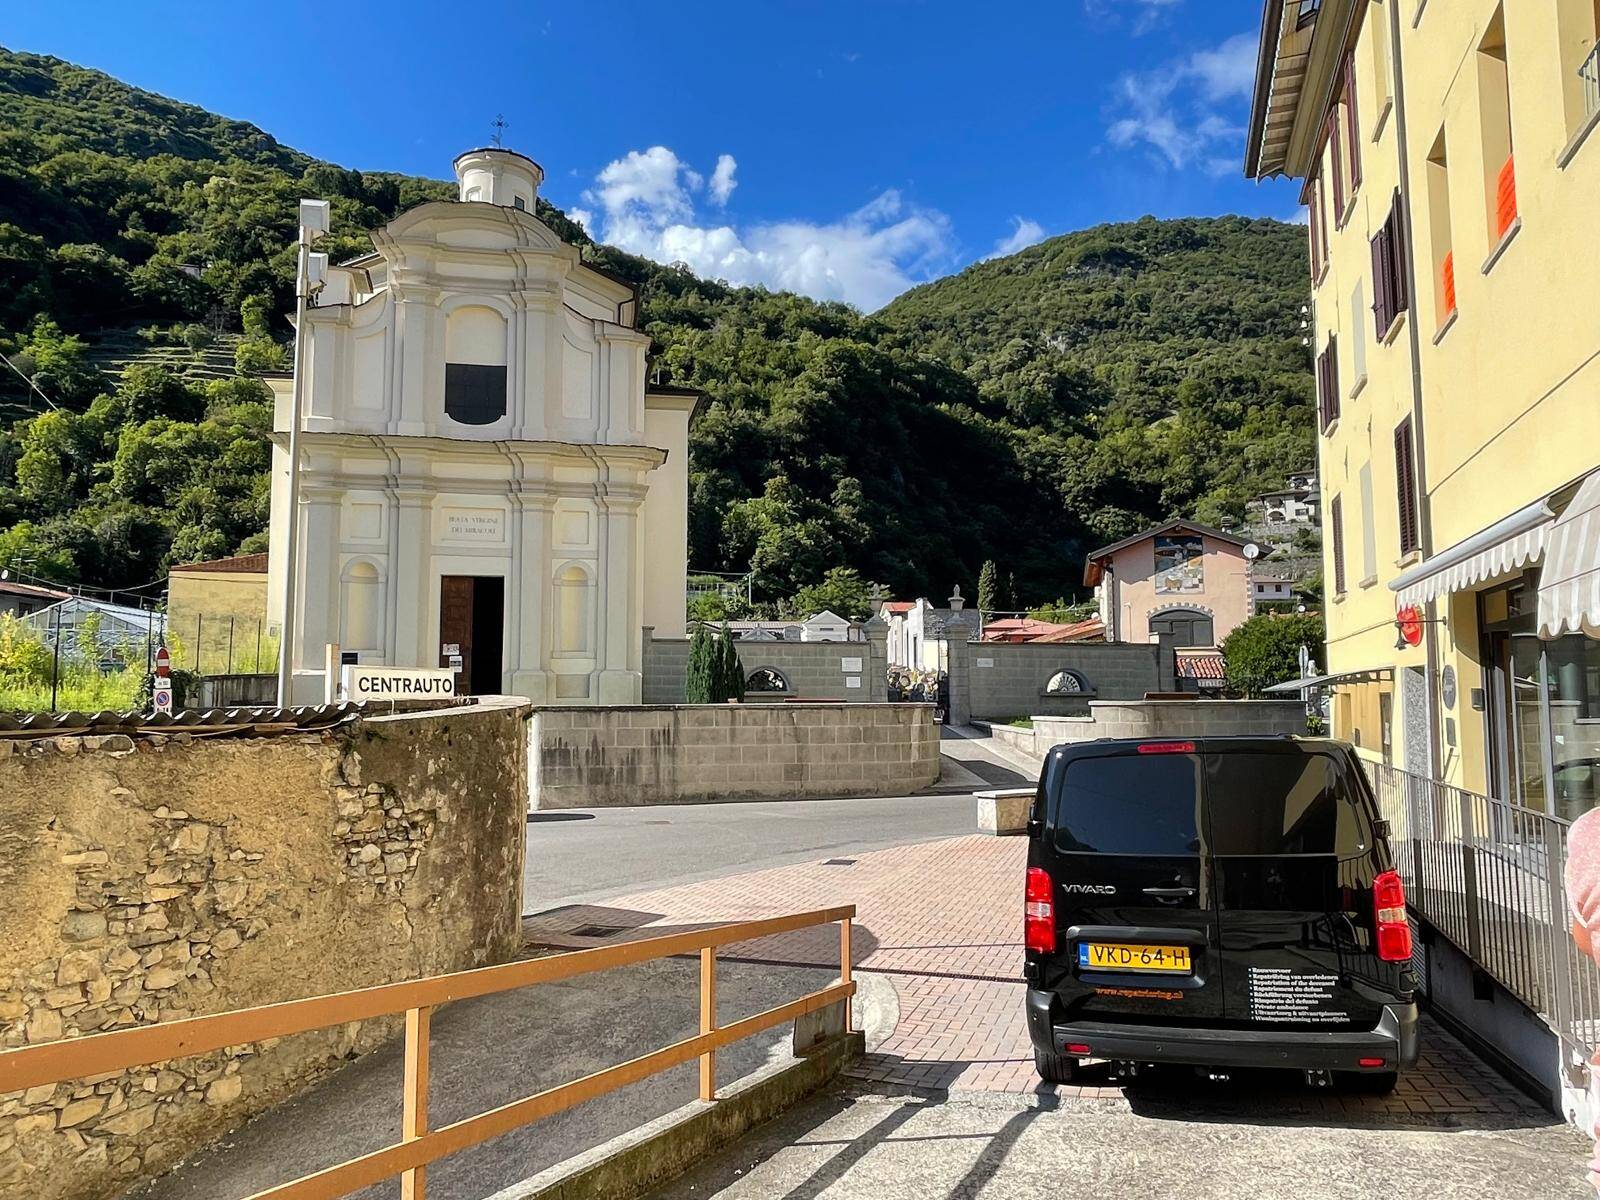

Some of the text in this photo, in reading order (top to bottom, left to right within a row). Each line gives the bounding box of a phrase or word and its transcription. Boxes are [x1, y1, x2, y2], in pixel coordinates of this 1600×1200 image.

[358, 677, 453, 693] CENTRAUTO
[1062, 883, 1117, 895] VIVARO
[1094, 945, 1186, 967] VKD-64-H
